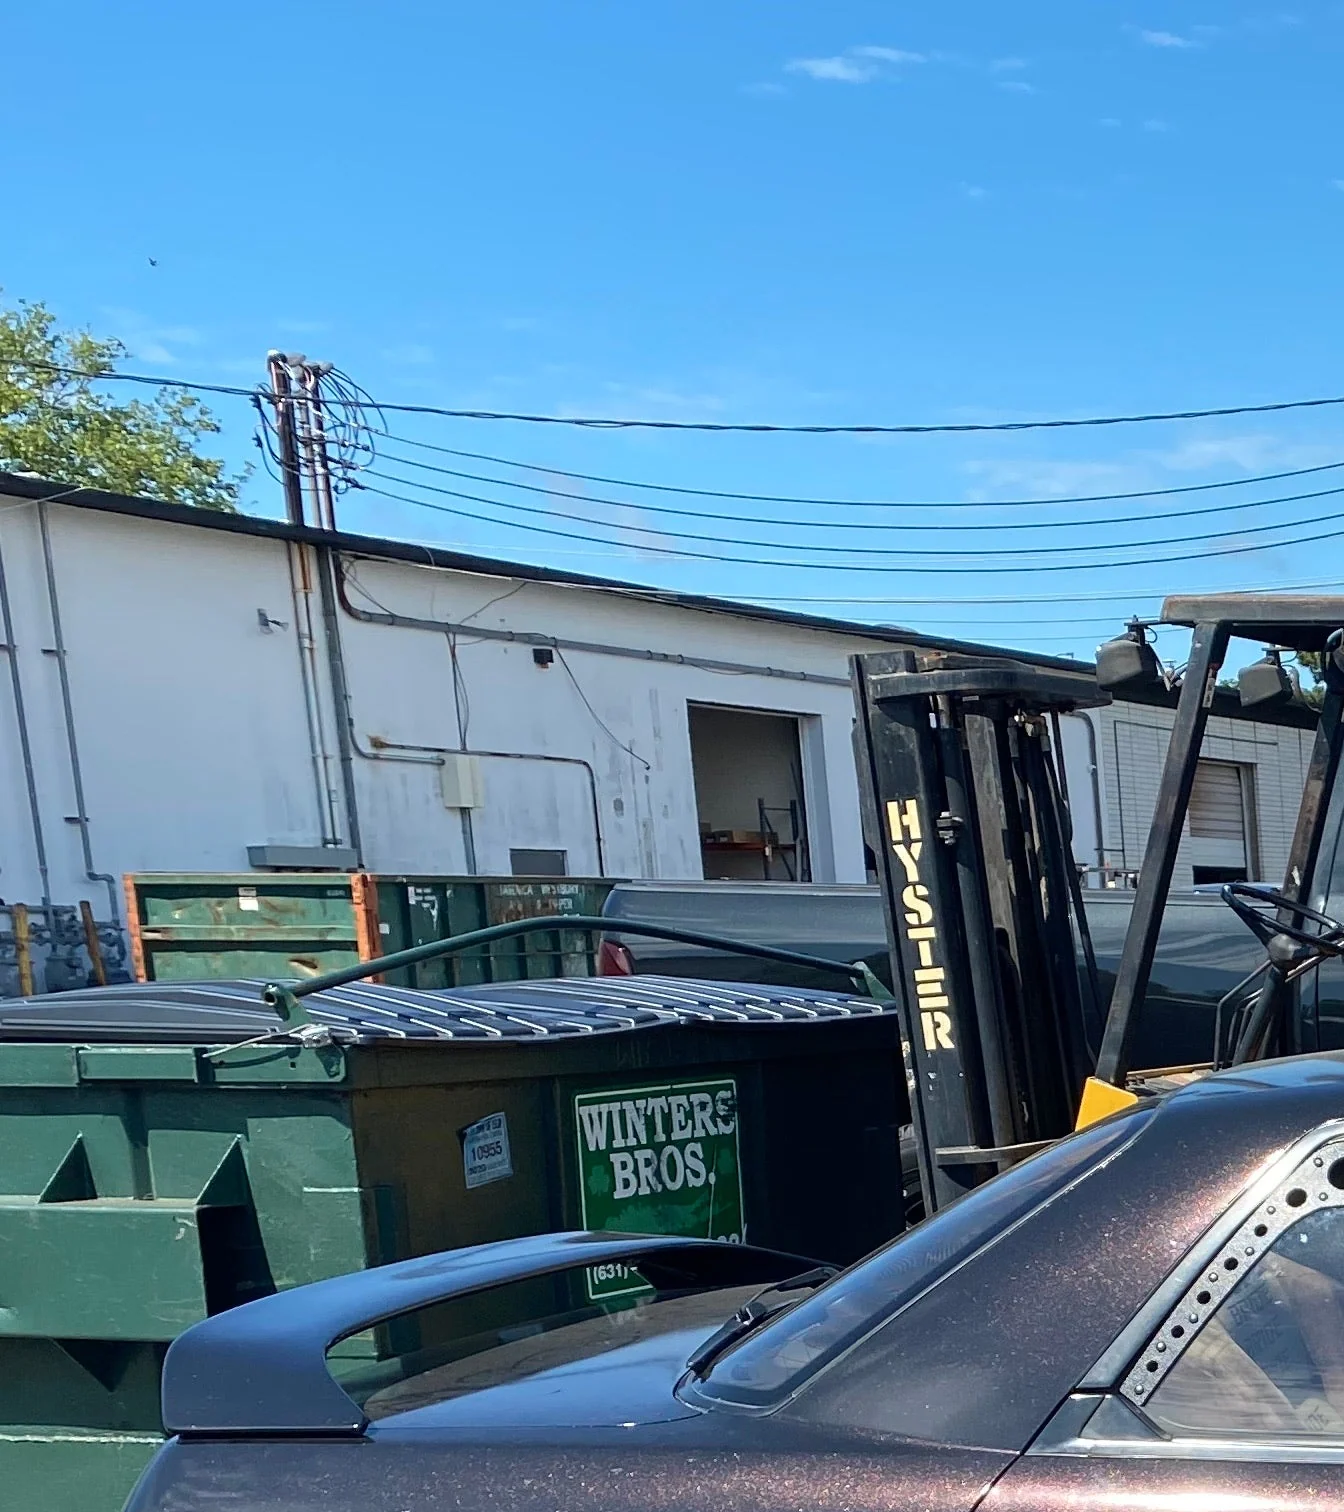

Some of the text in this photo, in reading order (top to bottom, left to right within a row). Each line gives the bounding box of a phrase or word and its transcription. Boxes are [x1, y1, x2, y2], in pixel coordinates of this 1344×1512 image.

[886, 799, 955, 1051] HYSTER
[579, 1090, 736, 1151] WINTERS
[471, 1140, 502, 1161] 10955
[609, 1142, 716, 1199] BROS.
